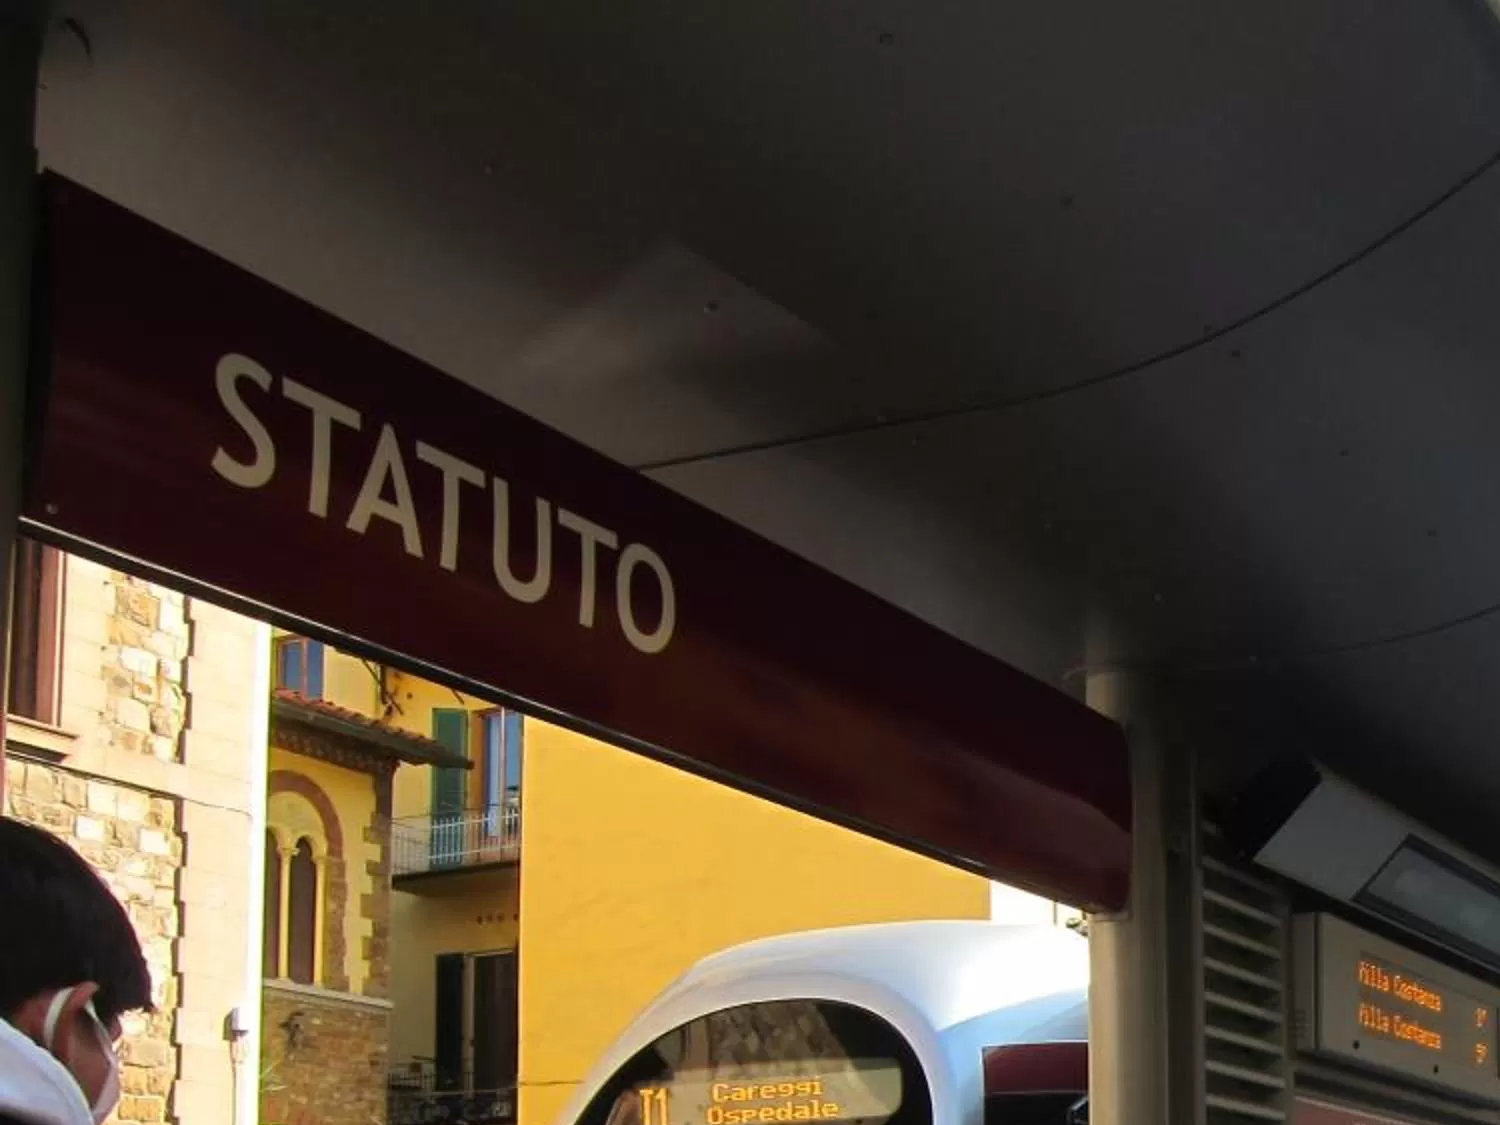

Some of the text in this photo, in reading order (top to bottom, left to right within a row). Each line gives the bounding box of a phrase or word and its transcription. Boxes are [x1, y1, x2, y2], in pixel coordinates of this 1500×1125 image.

[210, 353, 677, 654] STATUTO
[712, 1076, 824, 1102] Careggi
[707, 1100, 839, 1125] Ospedale
